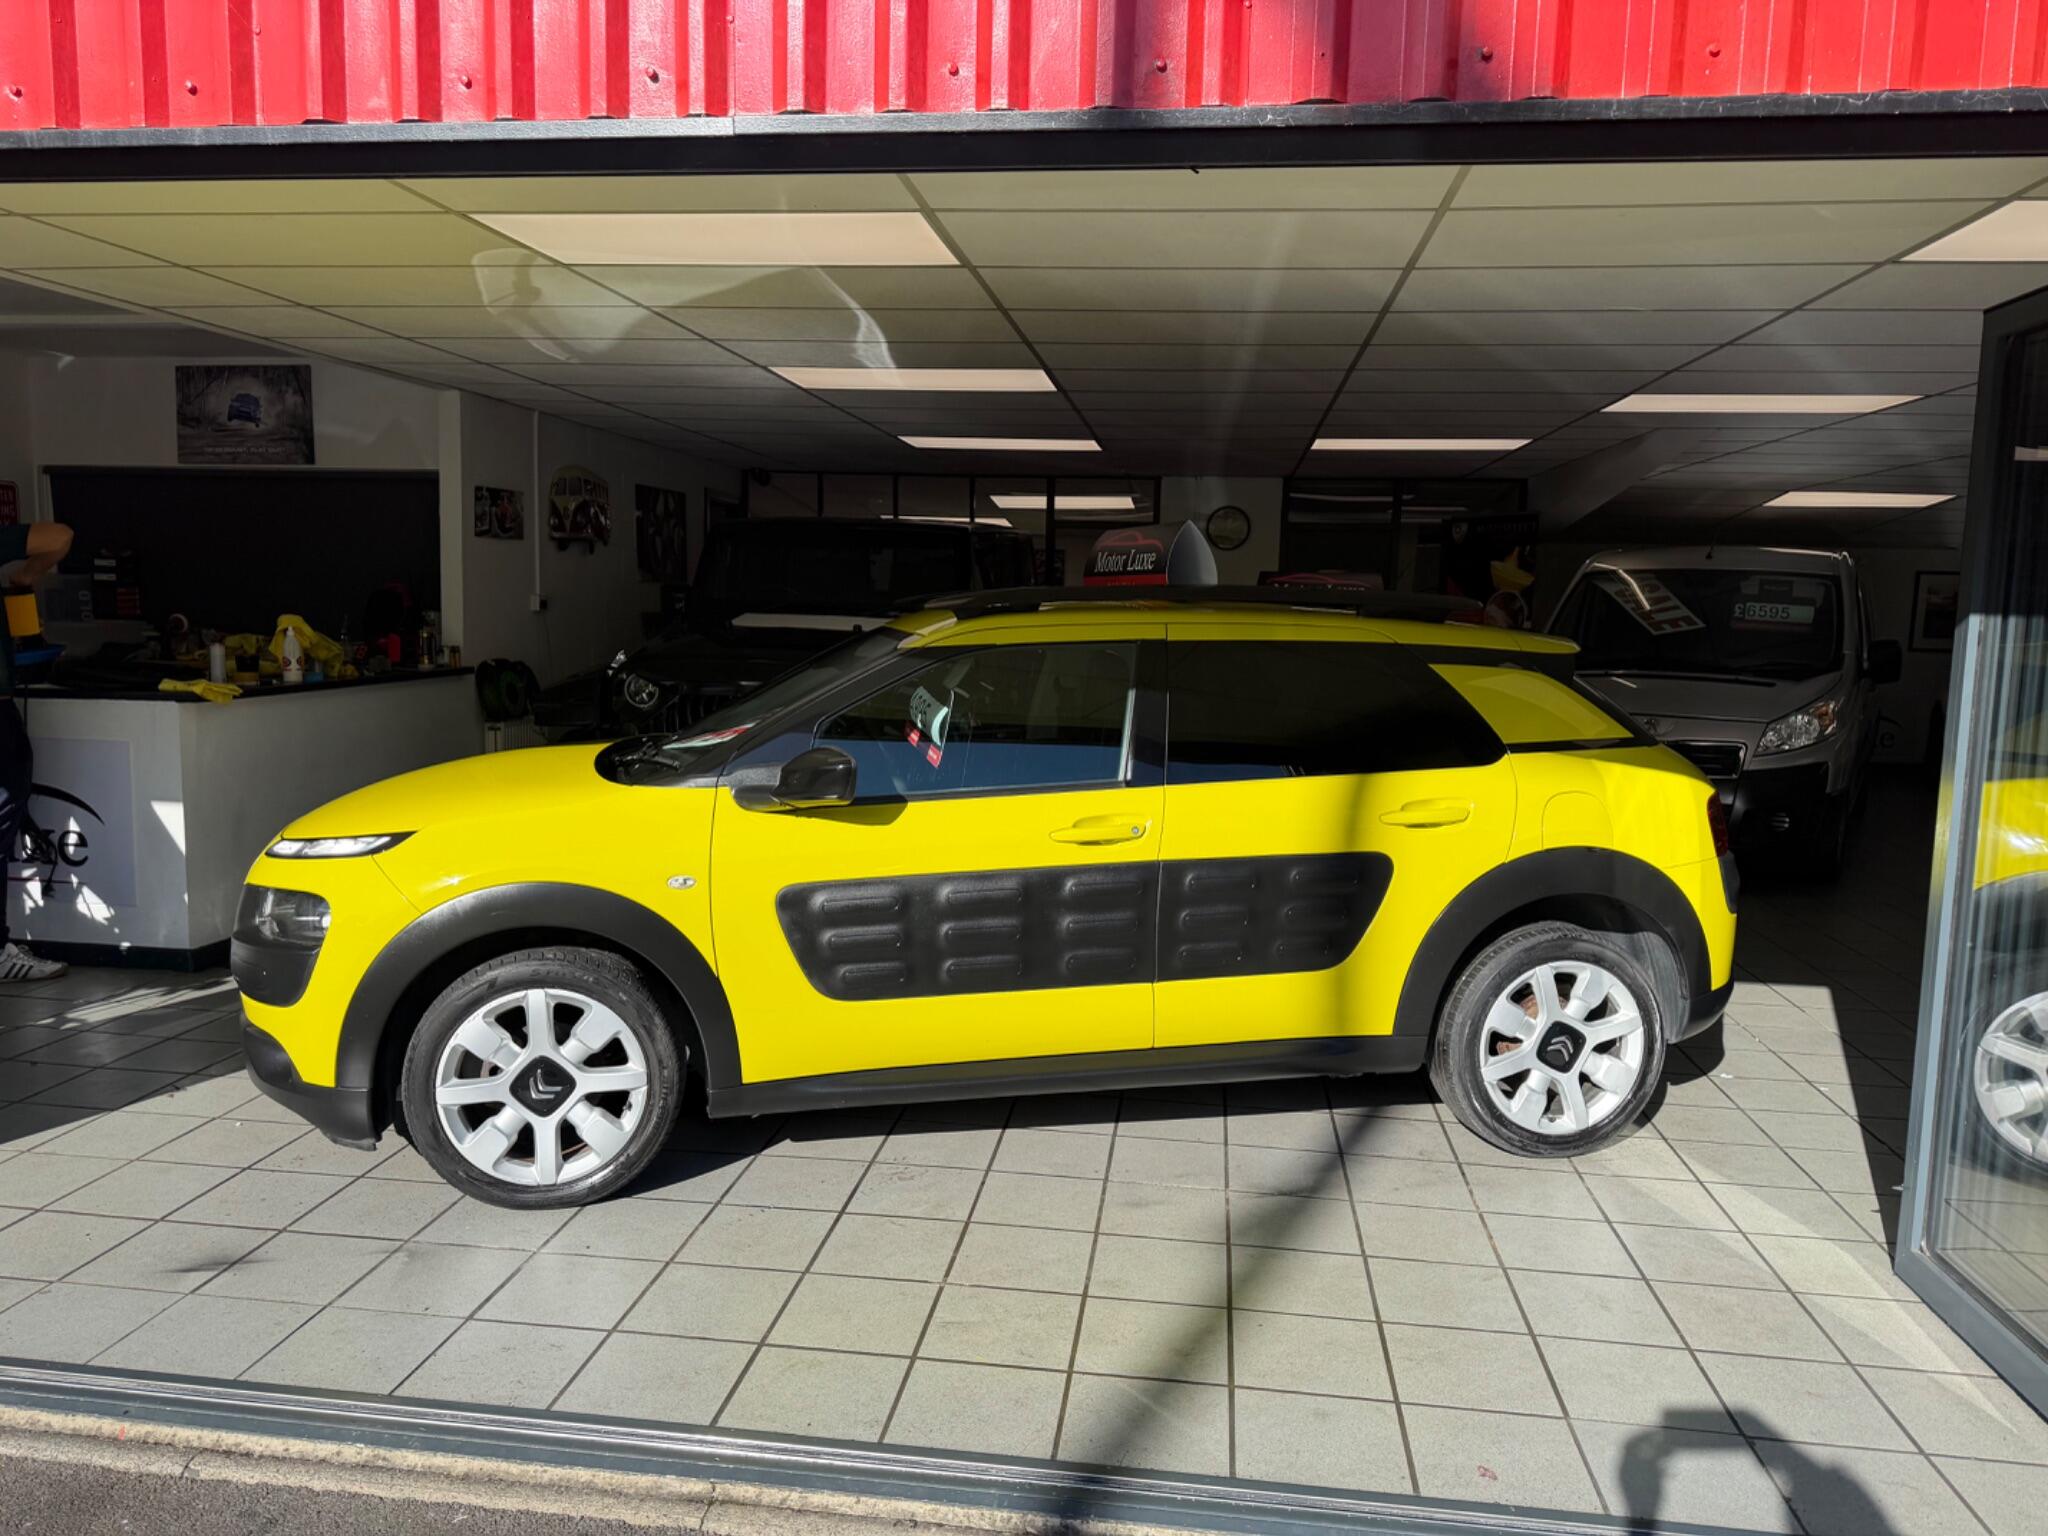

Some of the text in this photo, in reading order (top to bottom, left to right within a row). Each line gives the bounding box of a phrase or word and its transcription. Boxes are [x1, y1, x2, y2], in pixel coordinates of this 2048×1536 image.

[1094, 548, 1157, 574] Motor Luxe
[1733, 603, 1791, 621] £6595
